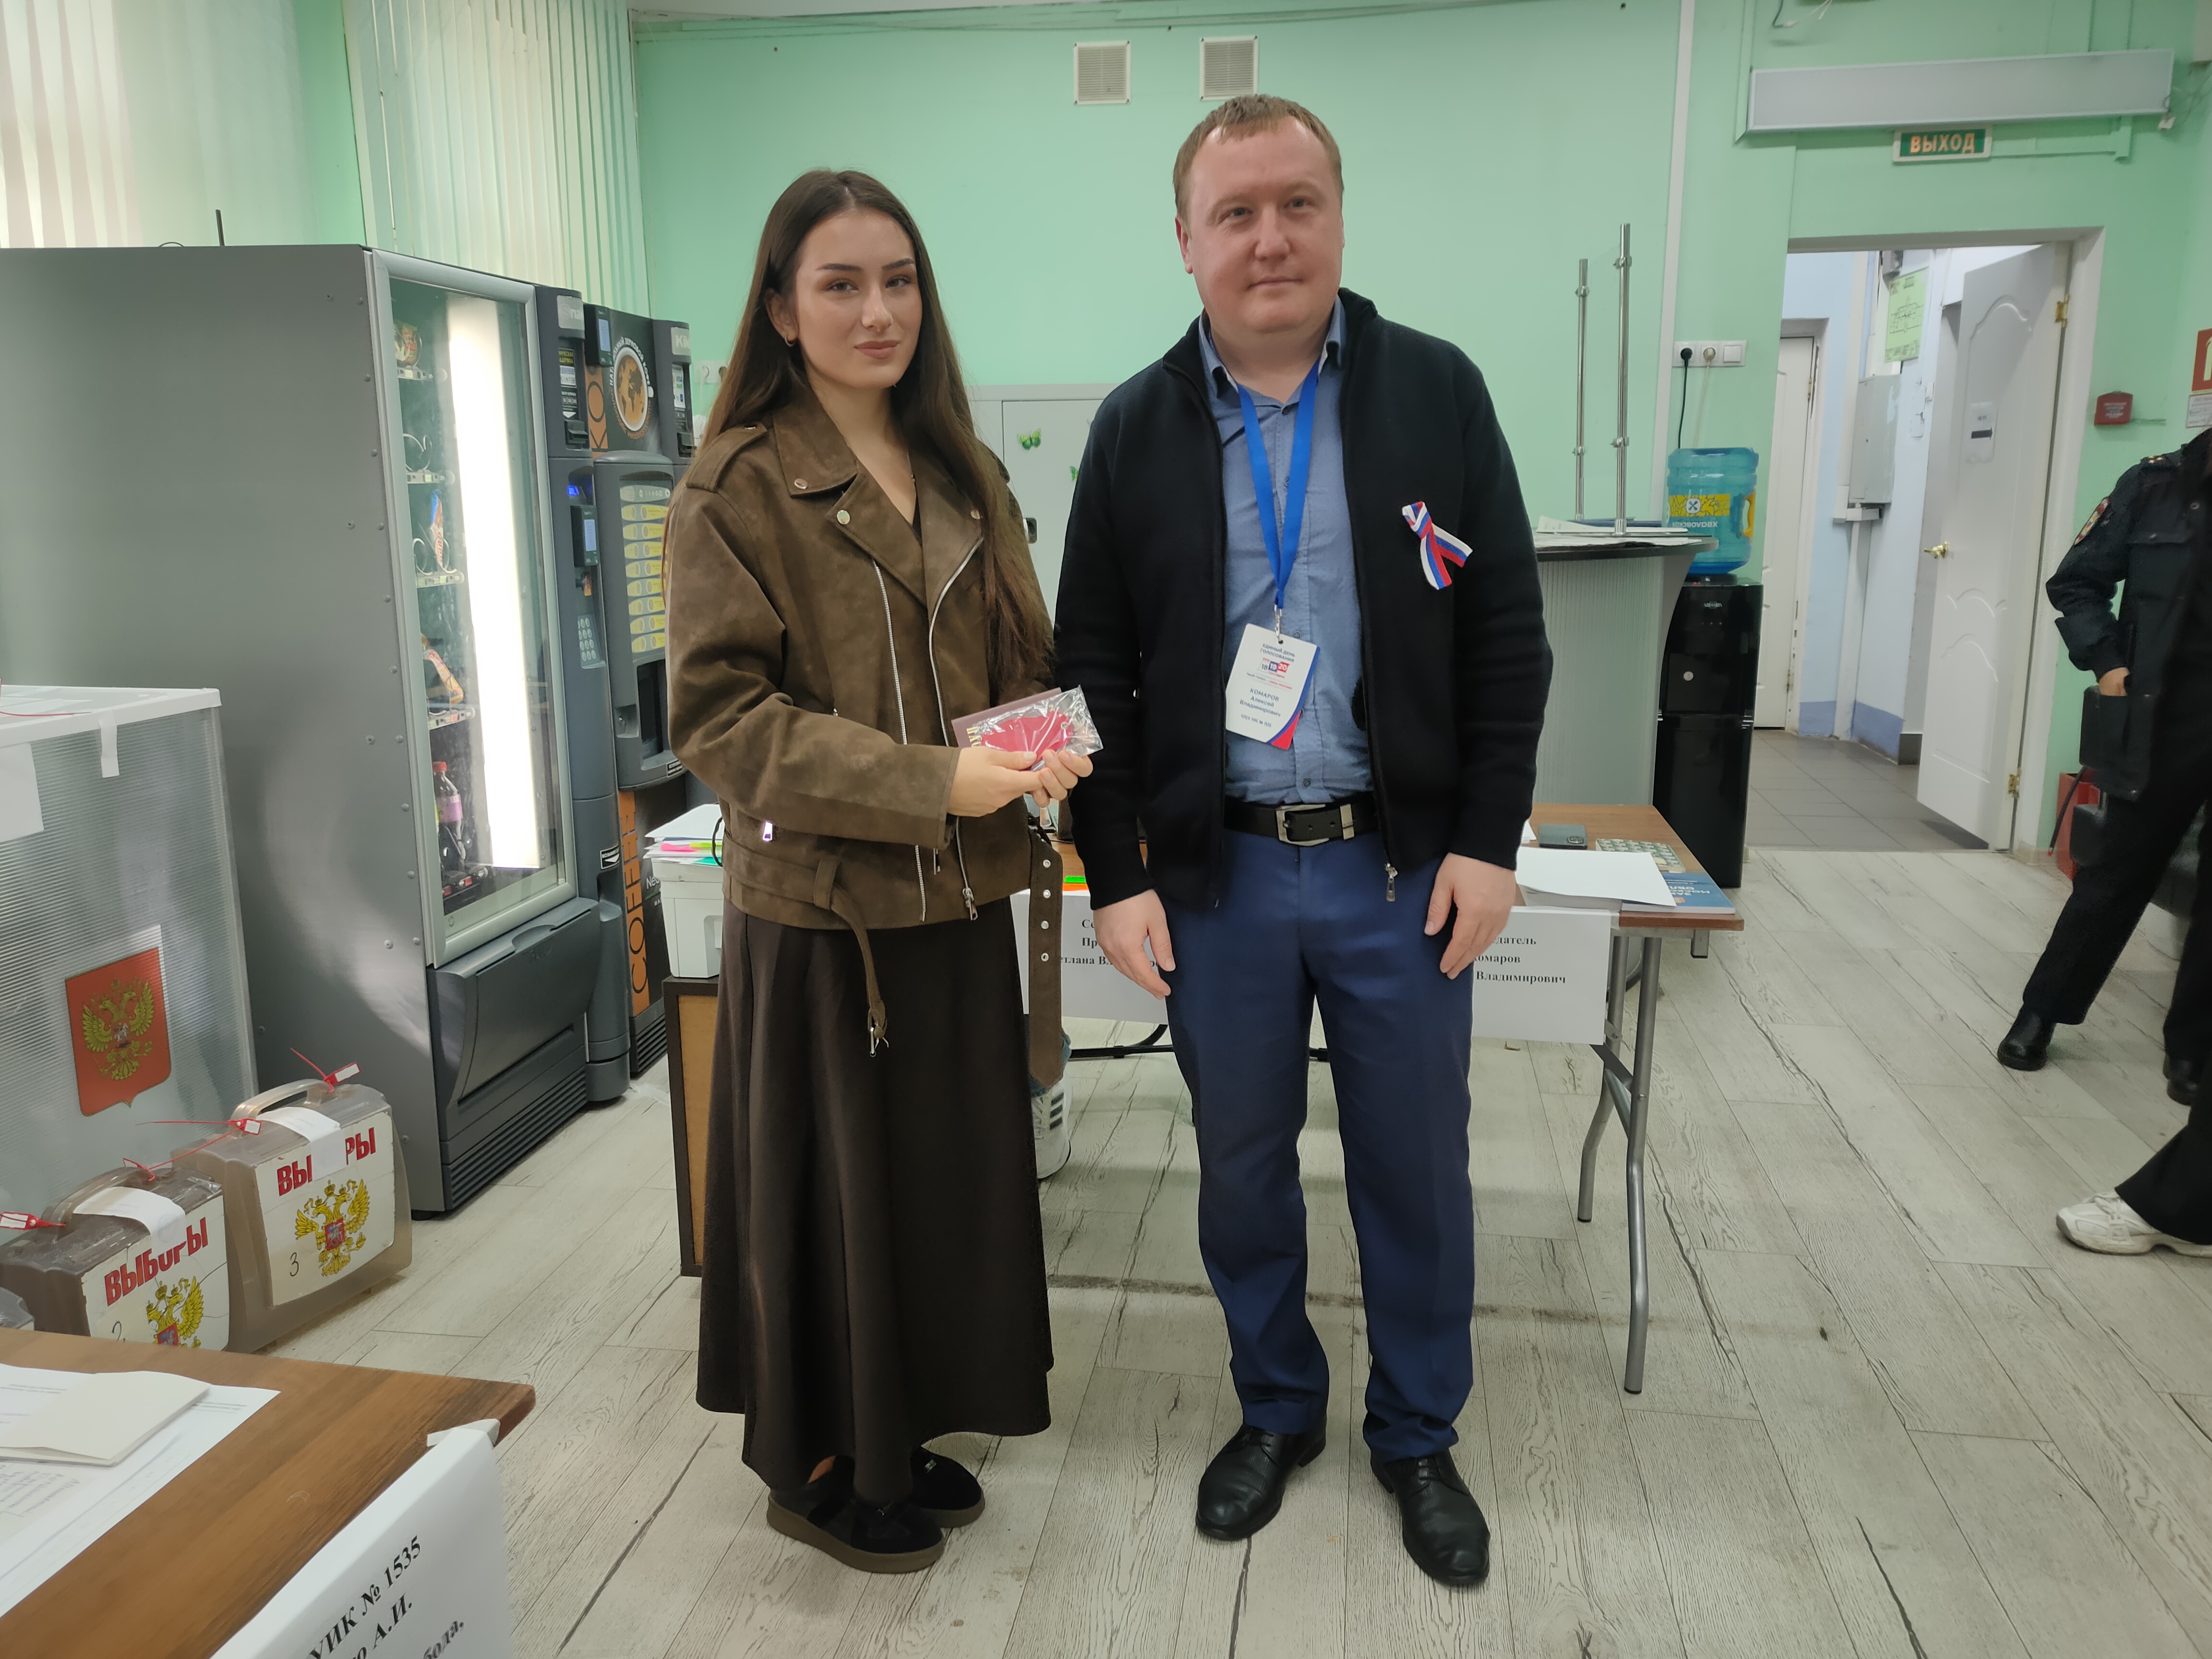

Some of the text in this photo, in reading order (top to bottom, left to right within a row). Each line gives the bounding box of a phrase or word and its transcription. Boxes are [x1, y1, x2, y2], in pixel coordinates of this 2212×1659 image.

[1911, 132, 1975, 154] ВЫХОД
[1261, 648, 1294, 662] ГОЛОСОВАНИЯ
[1262, 644, 1282, 652] ЕДИНЫЙ
[1250, 688, 1279, 701] КОМАРОВ
[1250, 696, 1274, 707] Алексей
[1240, 699, 1281, 717] Владимирович
[1476, 971, 1566, 985] Владимирович
[277, 1127, 376, 1196] ВЫРЫ
[290, 1252, 299, 1276] 3
[309, 1535, 421, 1659] УИК № 1535
[373, 1592, 412, 1650] А.И.
